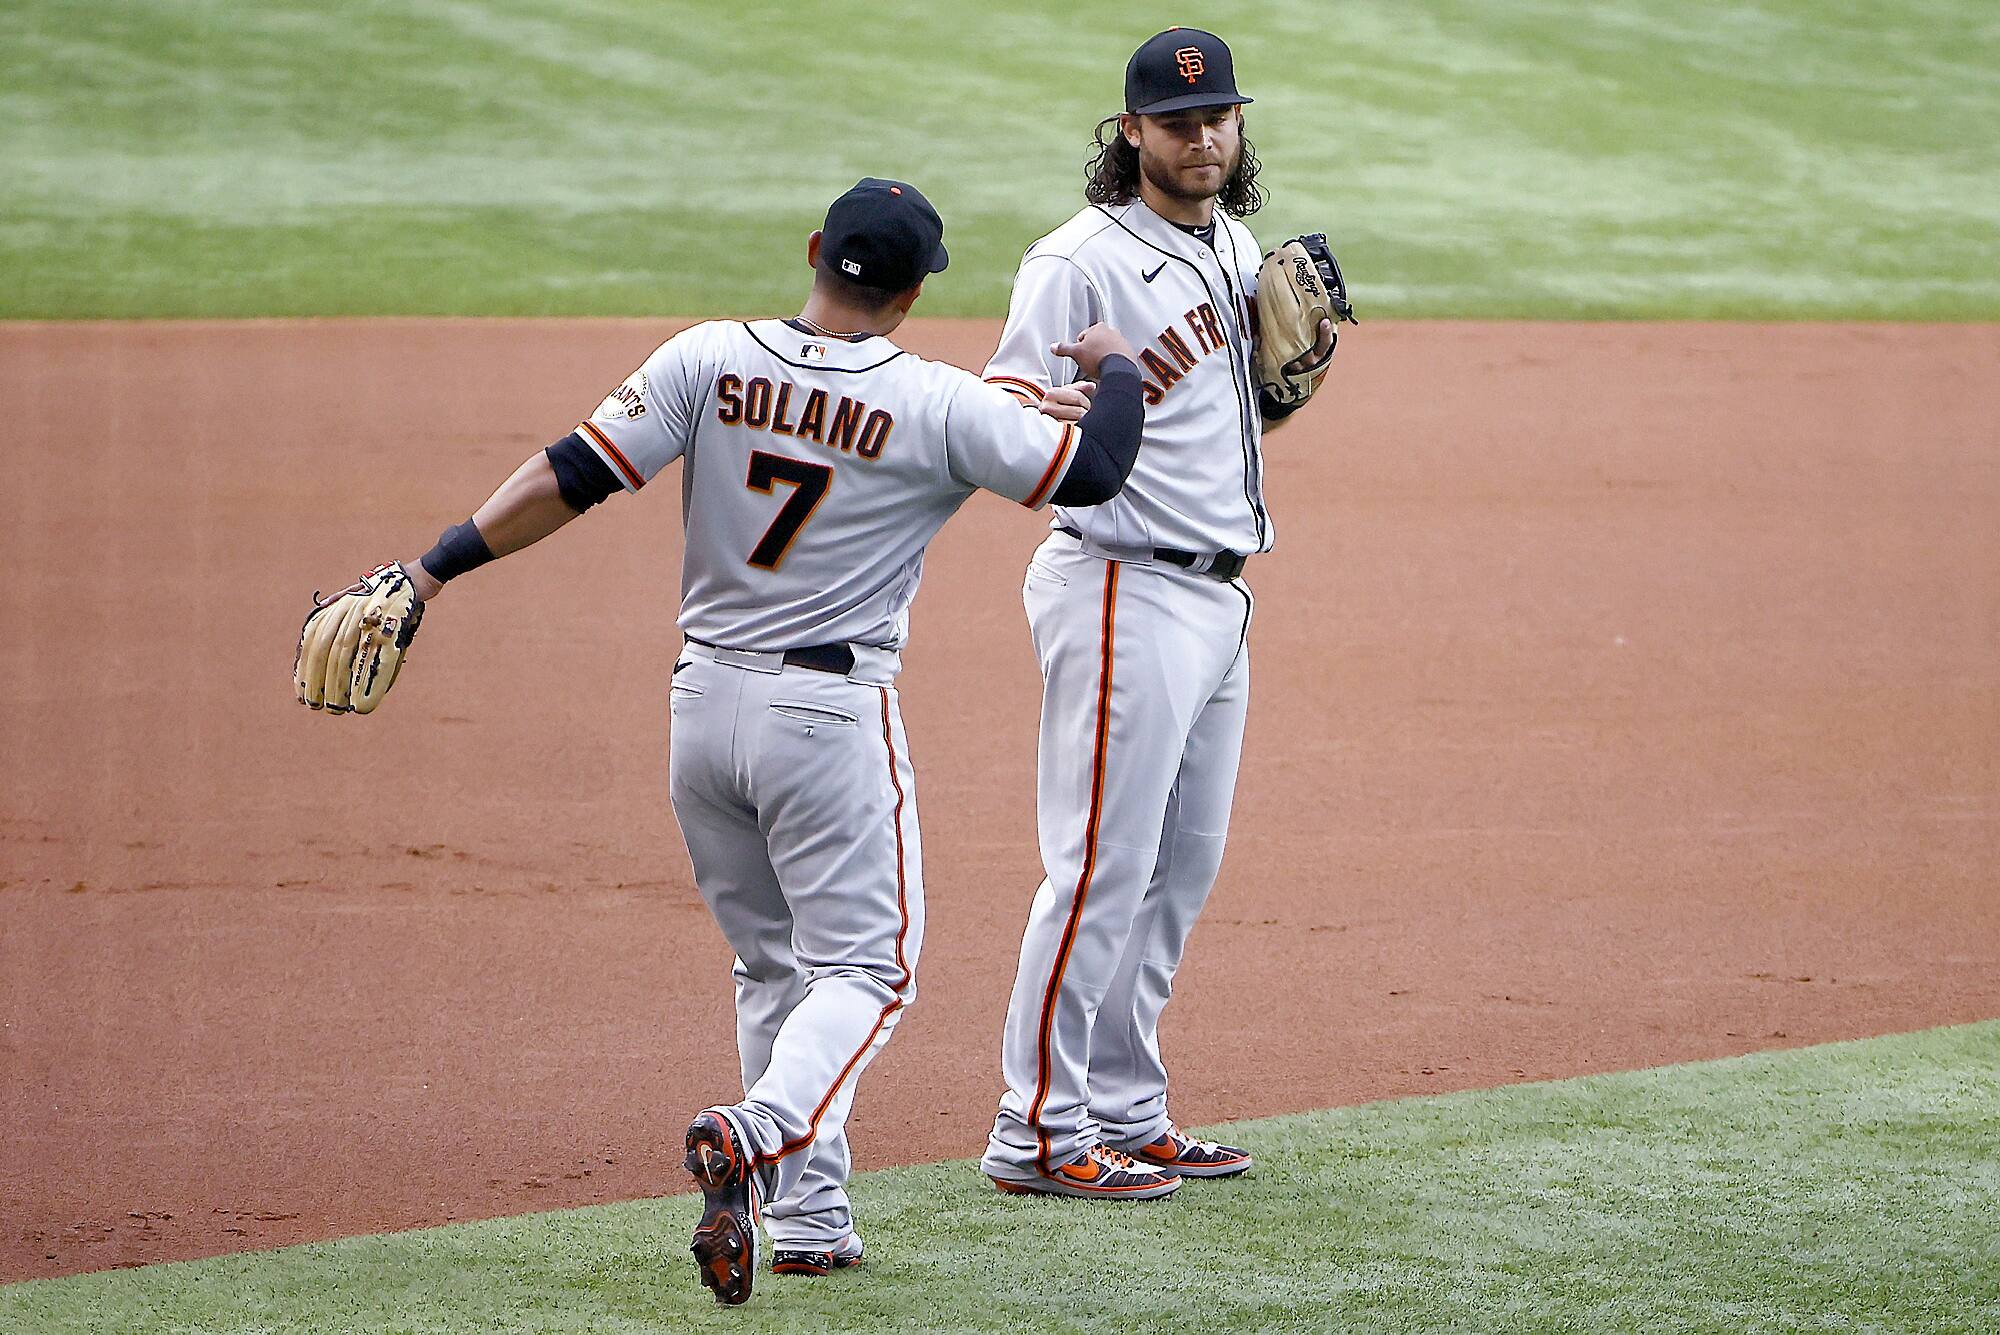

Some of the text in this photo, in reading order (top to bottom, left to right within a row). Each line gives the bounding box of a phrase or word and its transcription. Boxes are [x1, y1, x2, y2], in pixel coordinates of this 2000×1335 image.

[610, 384, 647, 418] IANTS
[717, 373, 894, 462] SOLANO
[746, 449, 834, 572] 7
